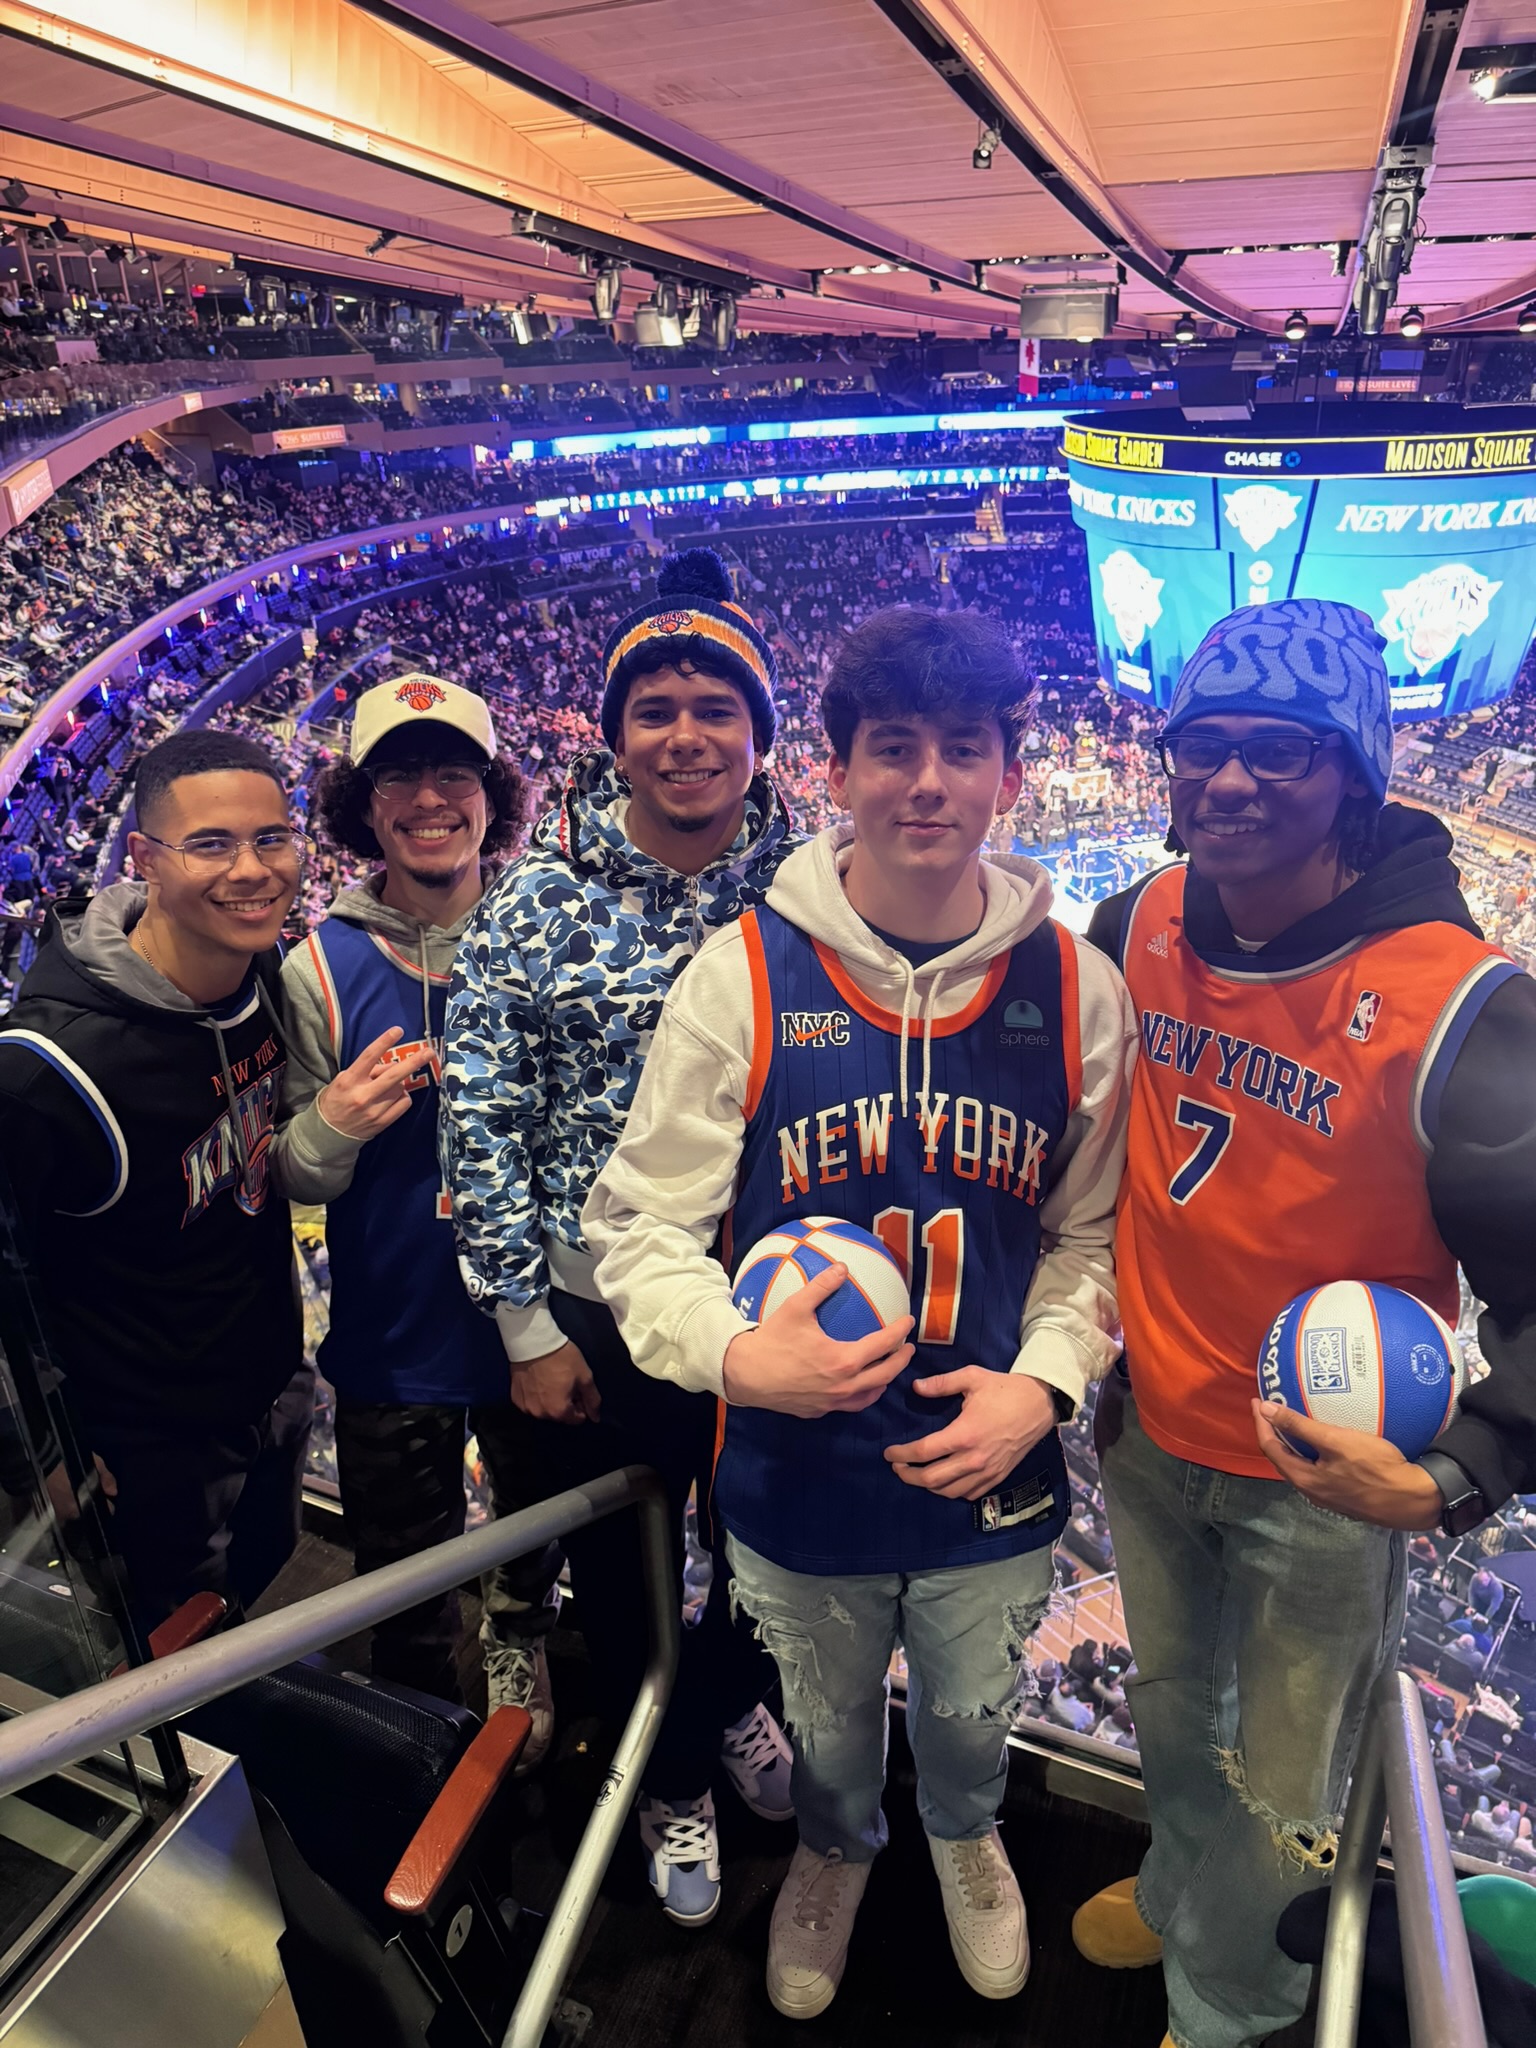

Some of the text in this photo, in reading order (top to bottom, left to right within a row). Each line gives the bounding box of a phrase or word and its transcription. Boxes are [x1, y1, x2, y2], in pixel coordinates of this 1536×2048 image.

[1391, 380, 1417, 389] LEVEL
[1119, 436, 1164, 468] GARDEN
[1224, 451, 1282, 467] CHASE
[1384, 436, 1534, 472] MADISON SQUARE
[1117, 495, 1196, 527] KNICKS
[1336, 504, 1420, 532] NEW
[1417, 501, 1500, 532] YORK
[558, 546, 612, 565] NEW YORK
[1147, 942, 1168, 958] adidas
[781, 1010, 850, 1047] NYC
[1000, 1032, 1050, 1047] sphere
[1348, 1026, 1364, 1039] NBA
[210, 1057, 251, 1097] NW
[1142, 1010, 1342, 1138] NEW YORK
[777, 1092, 1049, 1207] NEW YORK
[1168, 1093, 1237, 1207] 7
[872, 1205, 964, 1346] 11
[1310, 1333, 1327, 1375] HARDWOOD
[1326, 1332, 1341, 1373] CLASSICS
